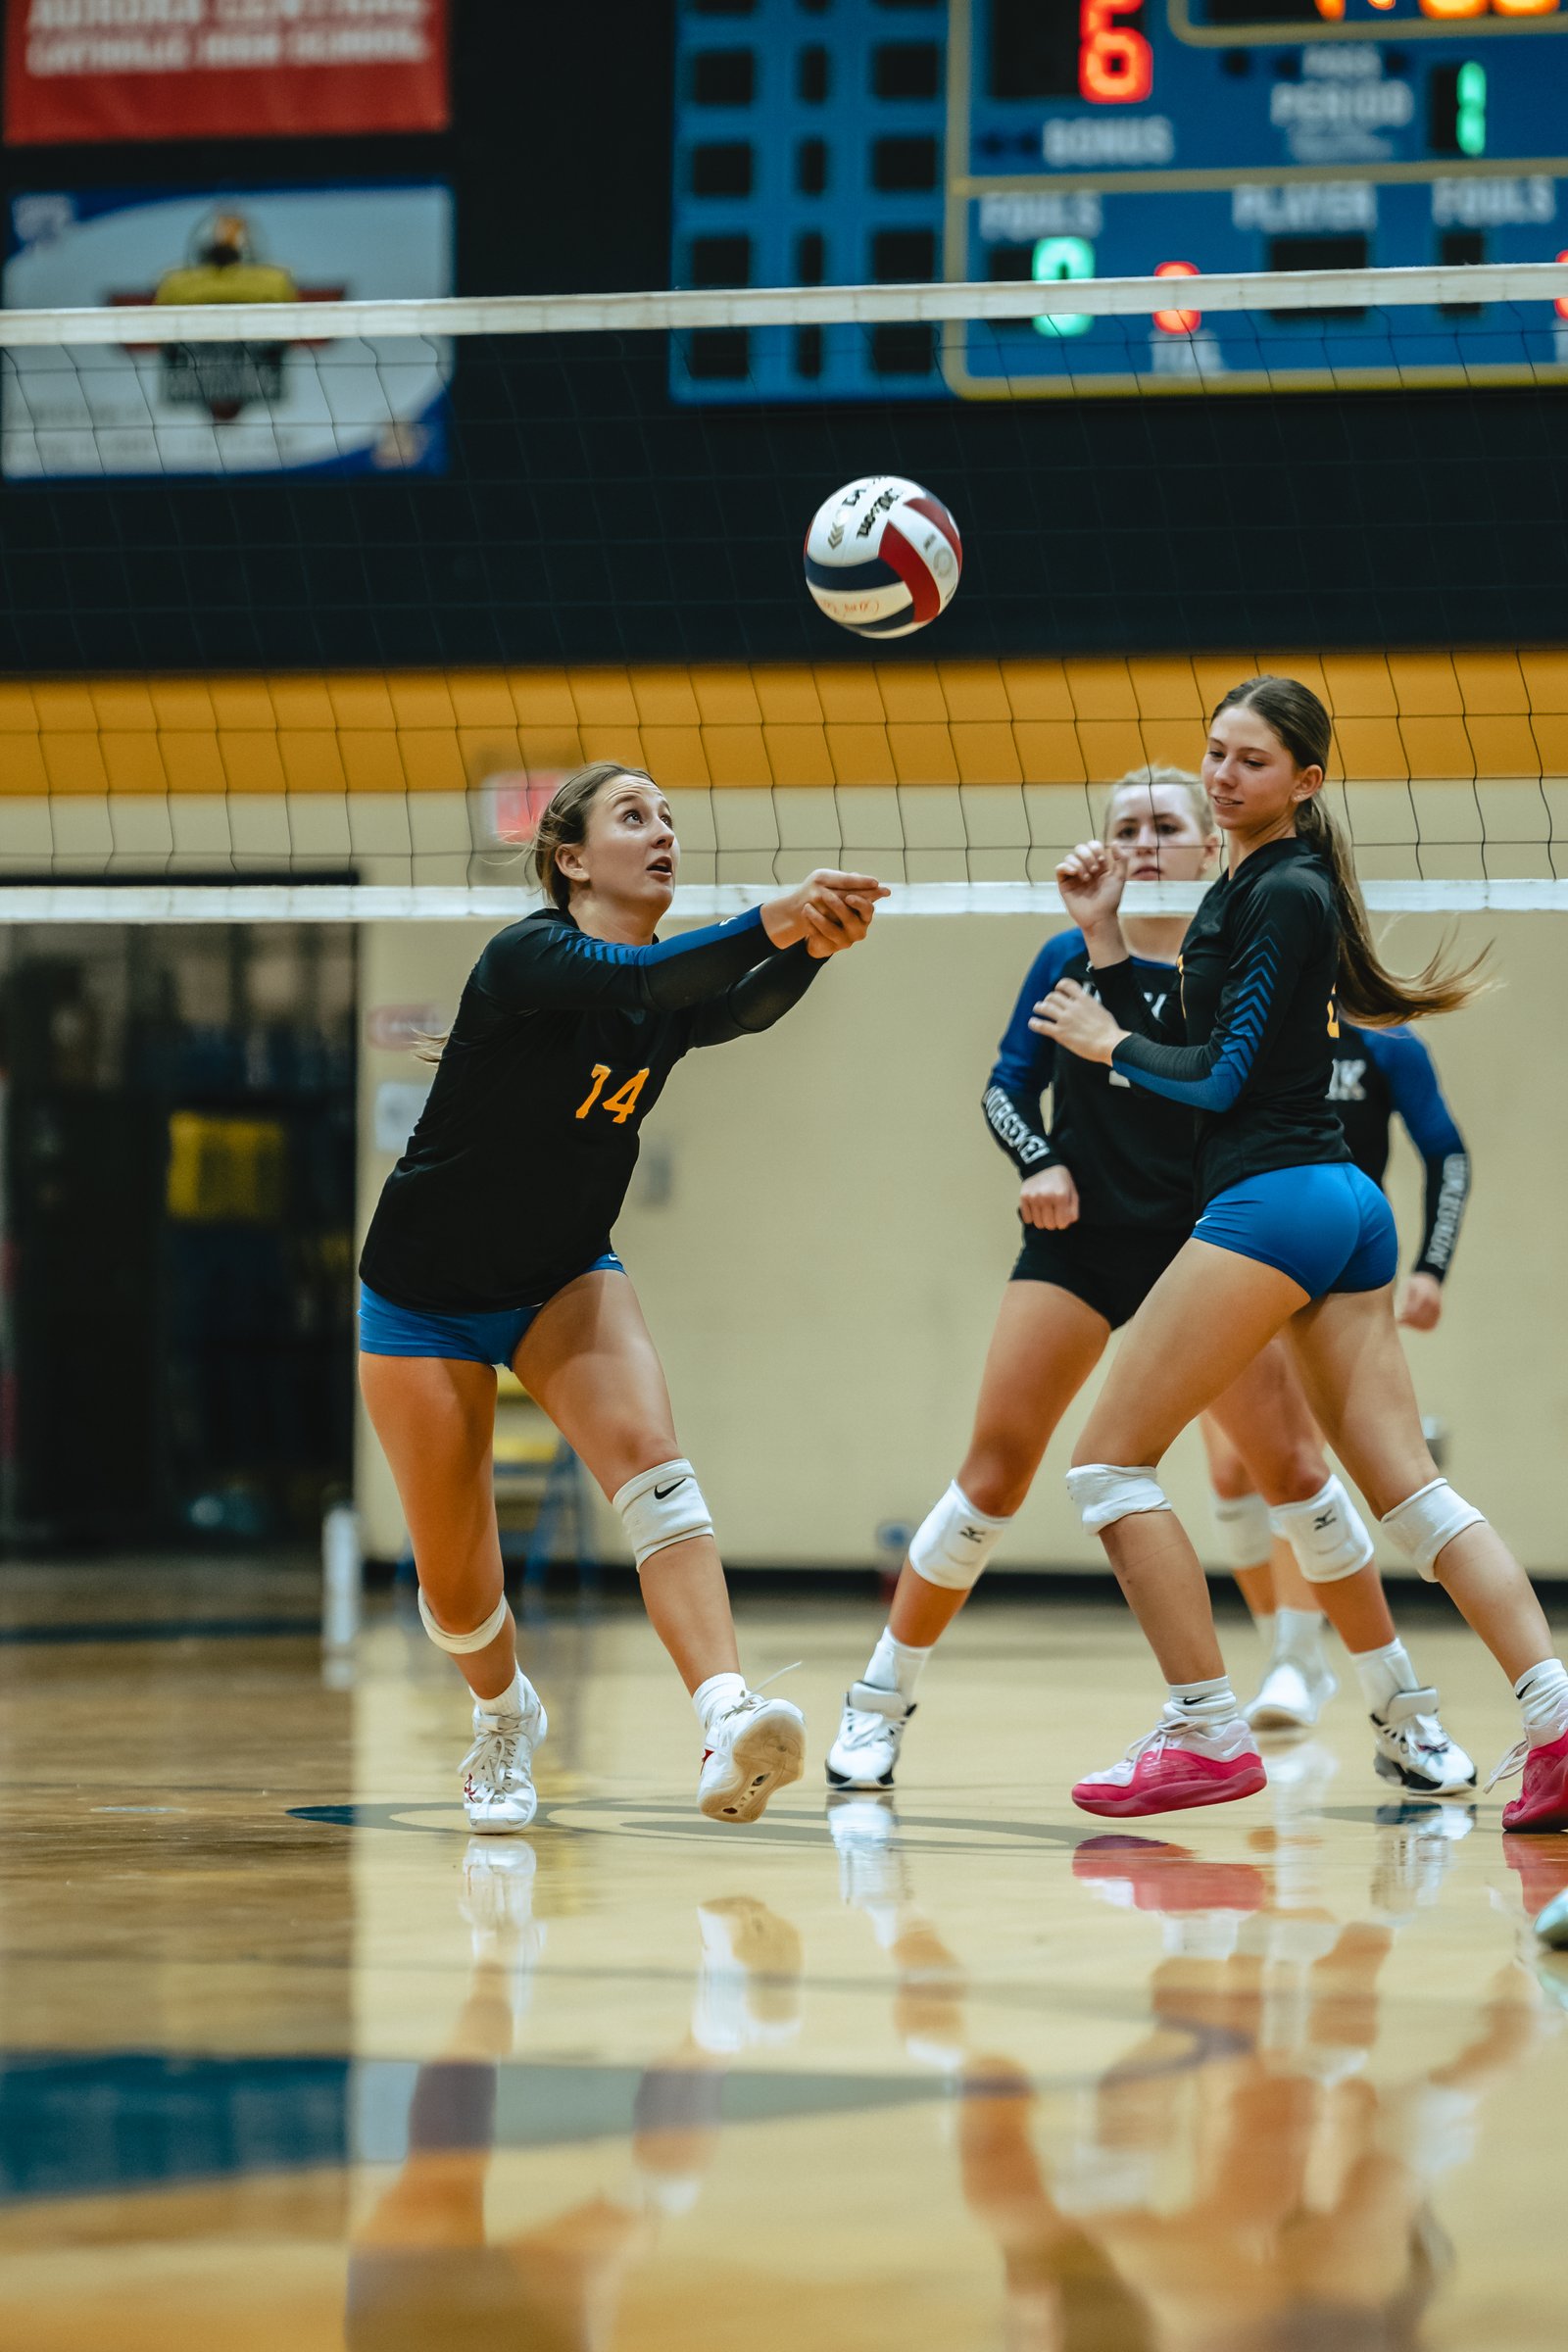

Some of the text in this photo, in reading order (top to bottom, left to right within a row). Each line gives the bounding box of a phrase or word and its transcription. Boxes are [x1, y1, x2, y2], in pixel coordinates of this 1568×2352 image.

[1078, 0, 1152, 104] 6
[1270, 79, 1414, 126] PERIOD
[1456, 60, 1486, 156] 1
[1043, 116, 1174, 165] BONUS
[980, 191, 1102, 240] FOULS
[1232, 180, 1378, 230] PLAYER
[1432, 175, 1556, 224] FOULS
[575, 1063, 650, 1124] 14
